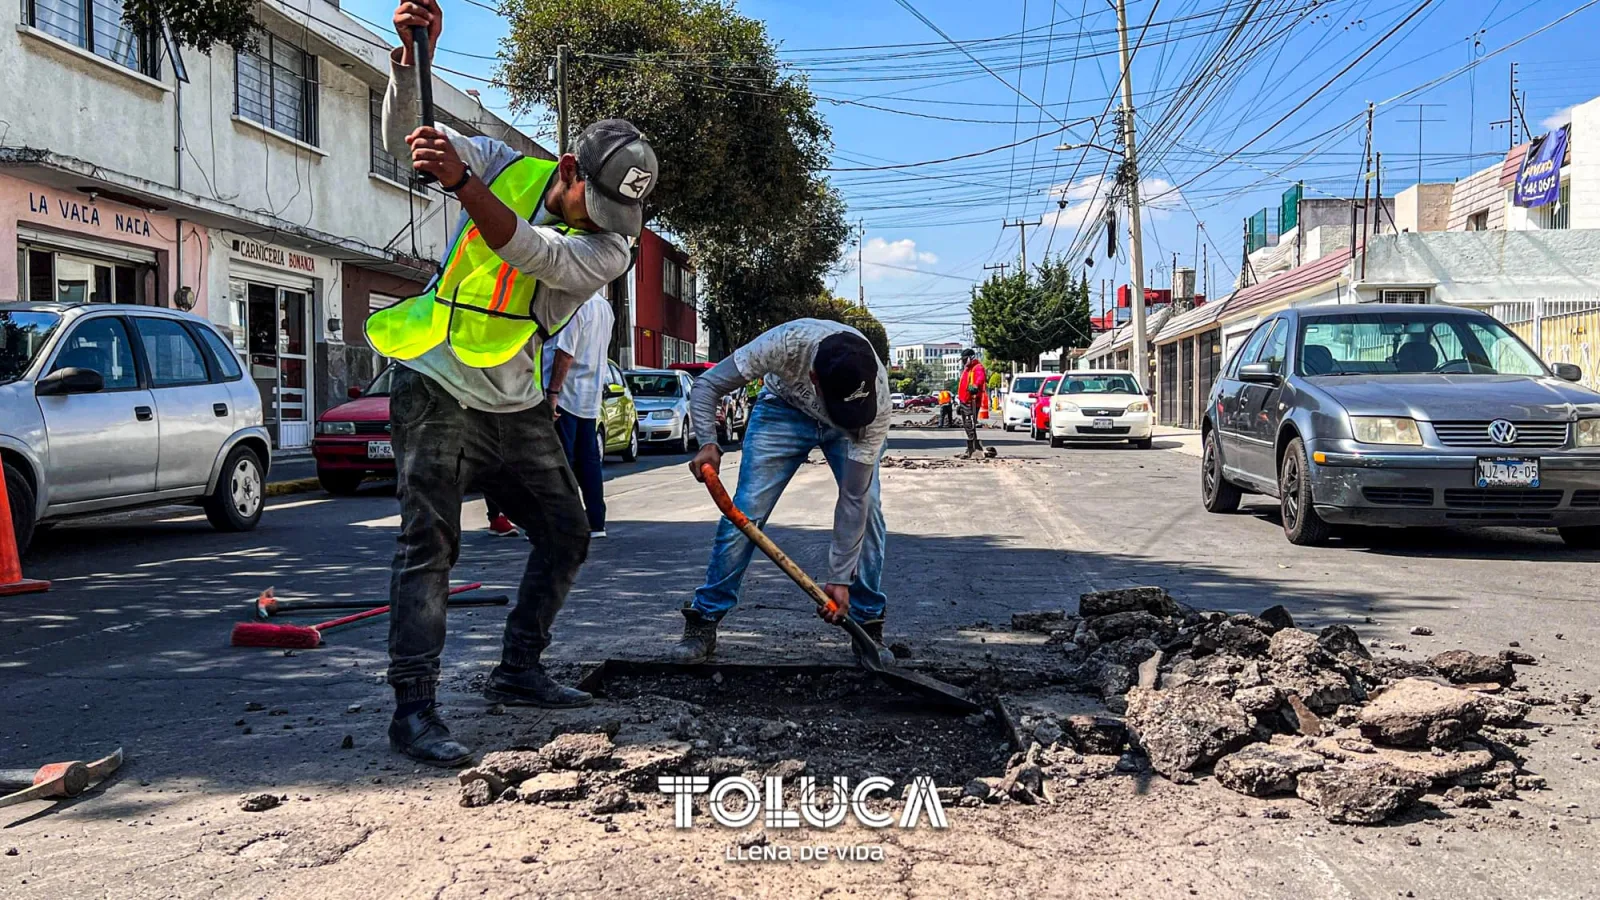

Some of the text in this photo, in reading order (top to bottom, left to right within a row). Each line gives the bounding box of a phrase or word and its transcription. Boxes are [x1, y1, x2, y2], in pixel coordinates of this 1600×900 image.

[29, 192, 150, 237] LA VACA NACA
[240, 241, 316, 272] CARNICERIA BONANZA
[1479, 464, 1537, 479] NJZ-12-05
